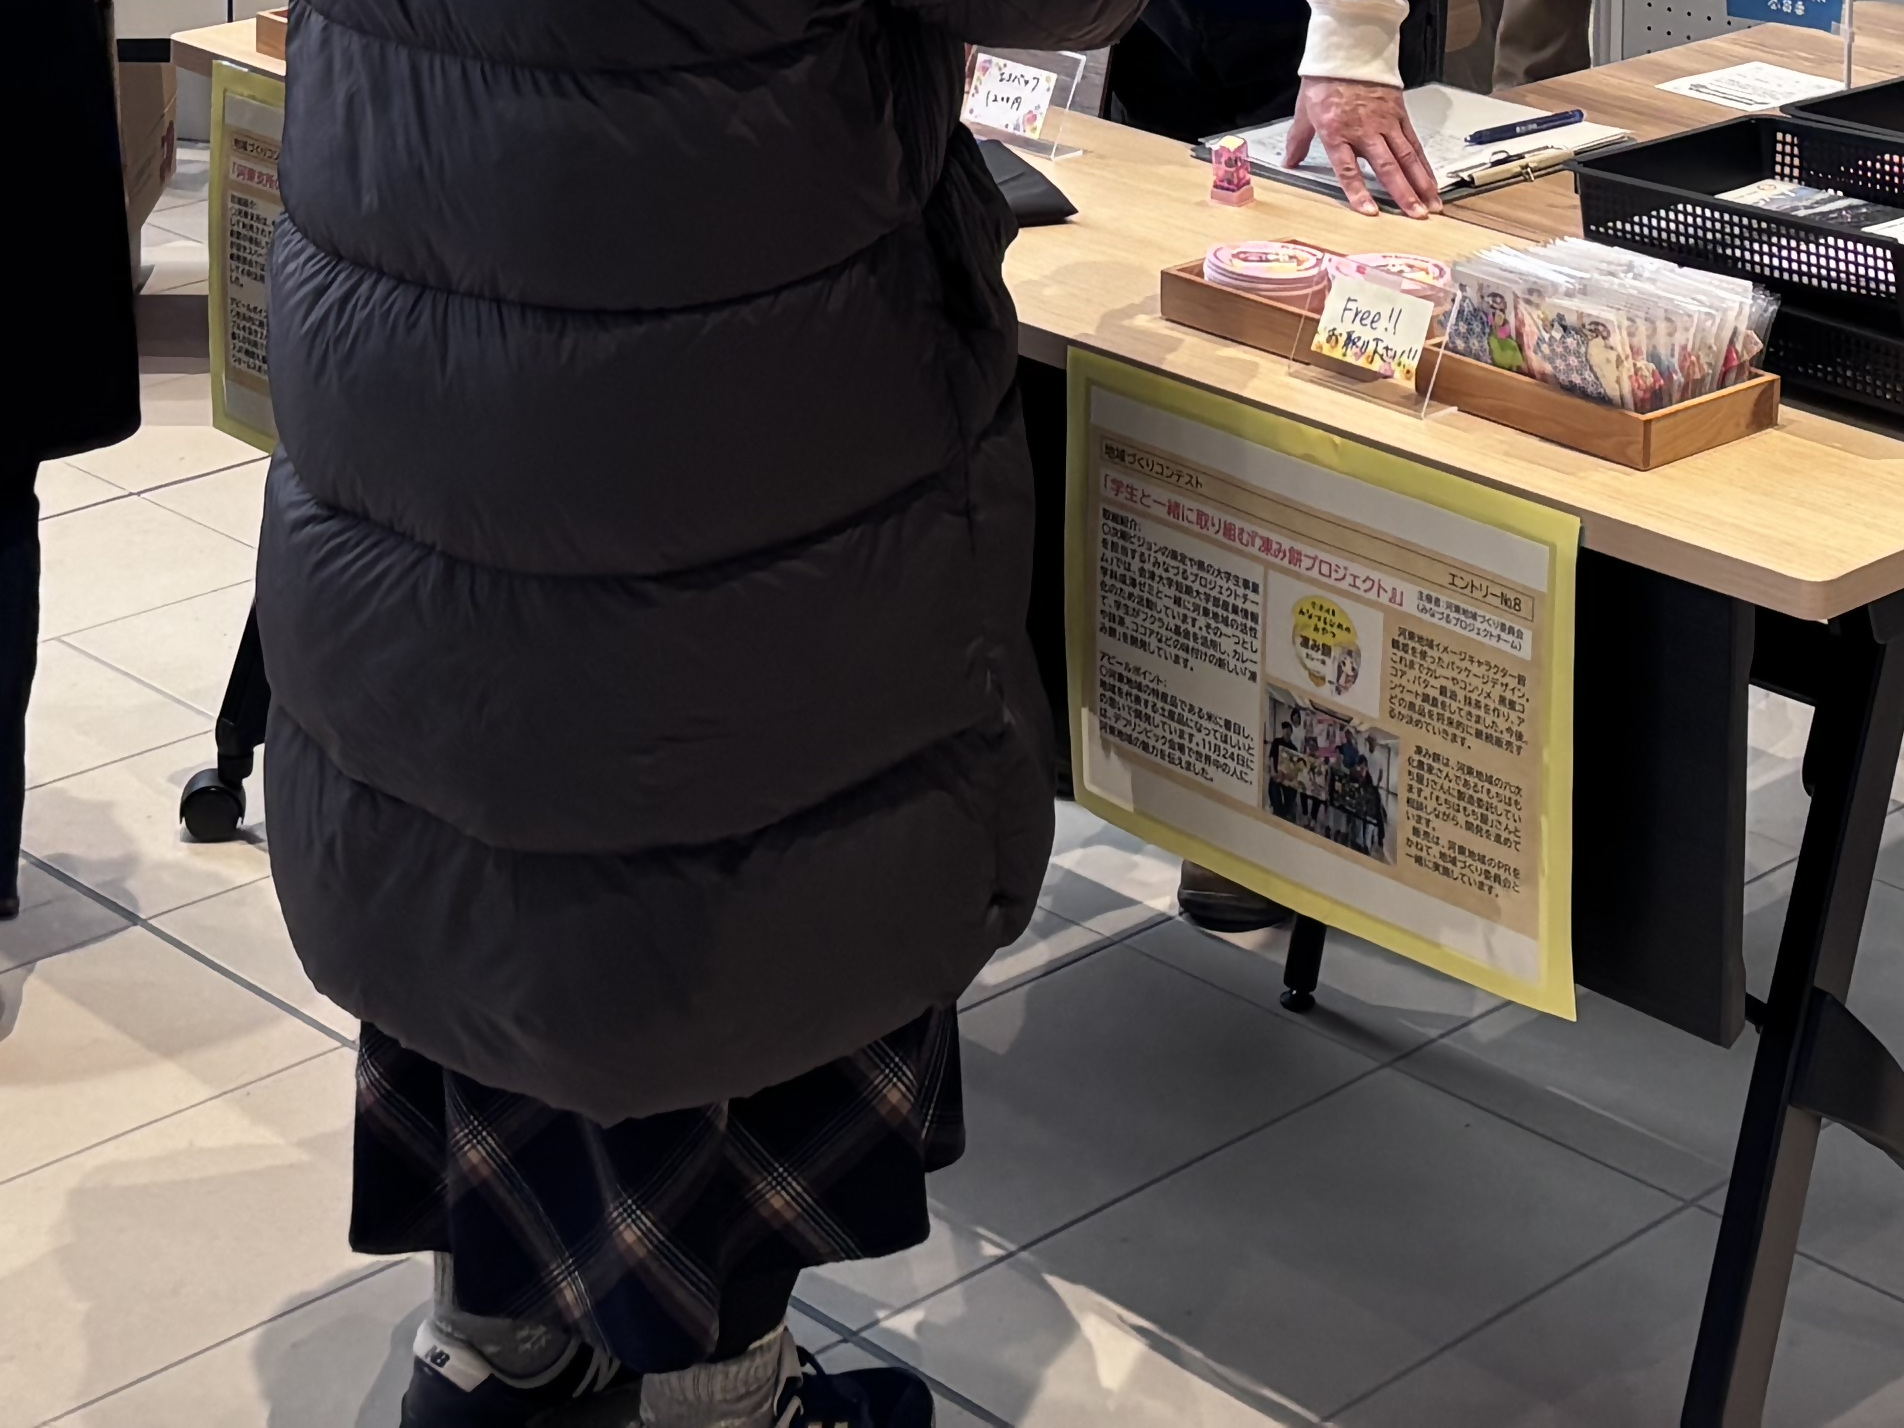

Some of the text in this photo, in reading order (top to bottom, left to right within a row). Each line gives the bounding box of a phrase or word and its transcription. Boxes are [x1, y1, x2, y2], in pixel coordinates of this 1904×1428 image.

[1104, 443, 1203, 490] 地域づくりコンテスト
